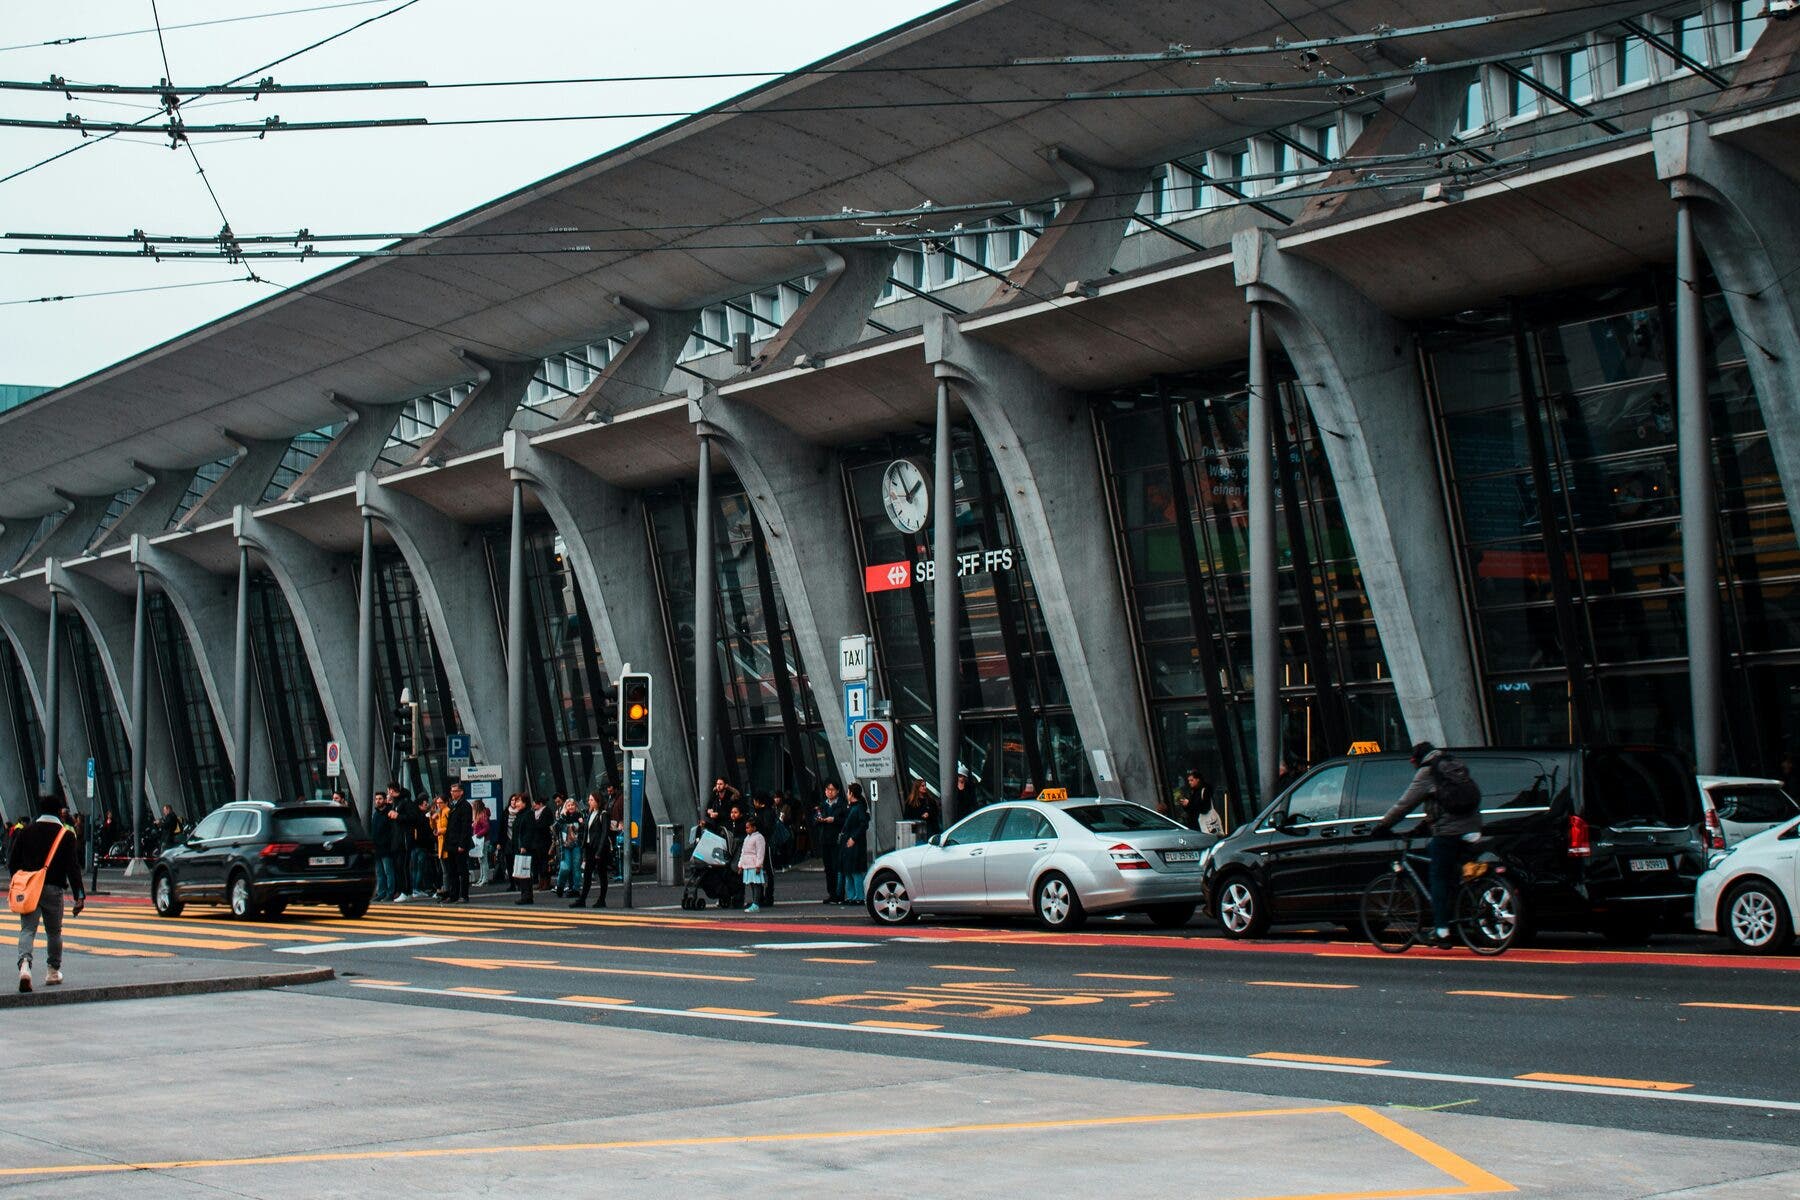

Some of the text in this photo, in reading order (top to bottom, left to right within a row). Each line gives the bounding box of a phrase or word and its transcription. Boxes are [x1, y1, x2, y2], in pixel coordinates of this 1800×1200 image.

[1212, 483, 1241, 496] einen
[915, 560, 935, 583] SB
[985, 548, 1013, 573] FFS
[843, 649, 864, 667] TAXI
[451, 738, 462, 755] P
[1358, 745, 1378, 754] TAXI
[1046, 792, 1065, 800] TAXI
[788, 981, 1175, 1019] BUS
